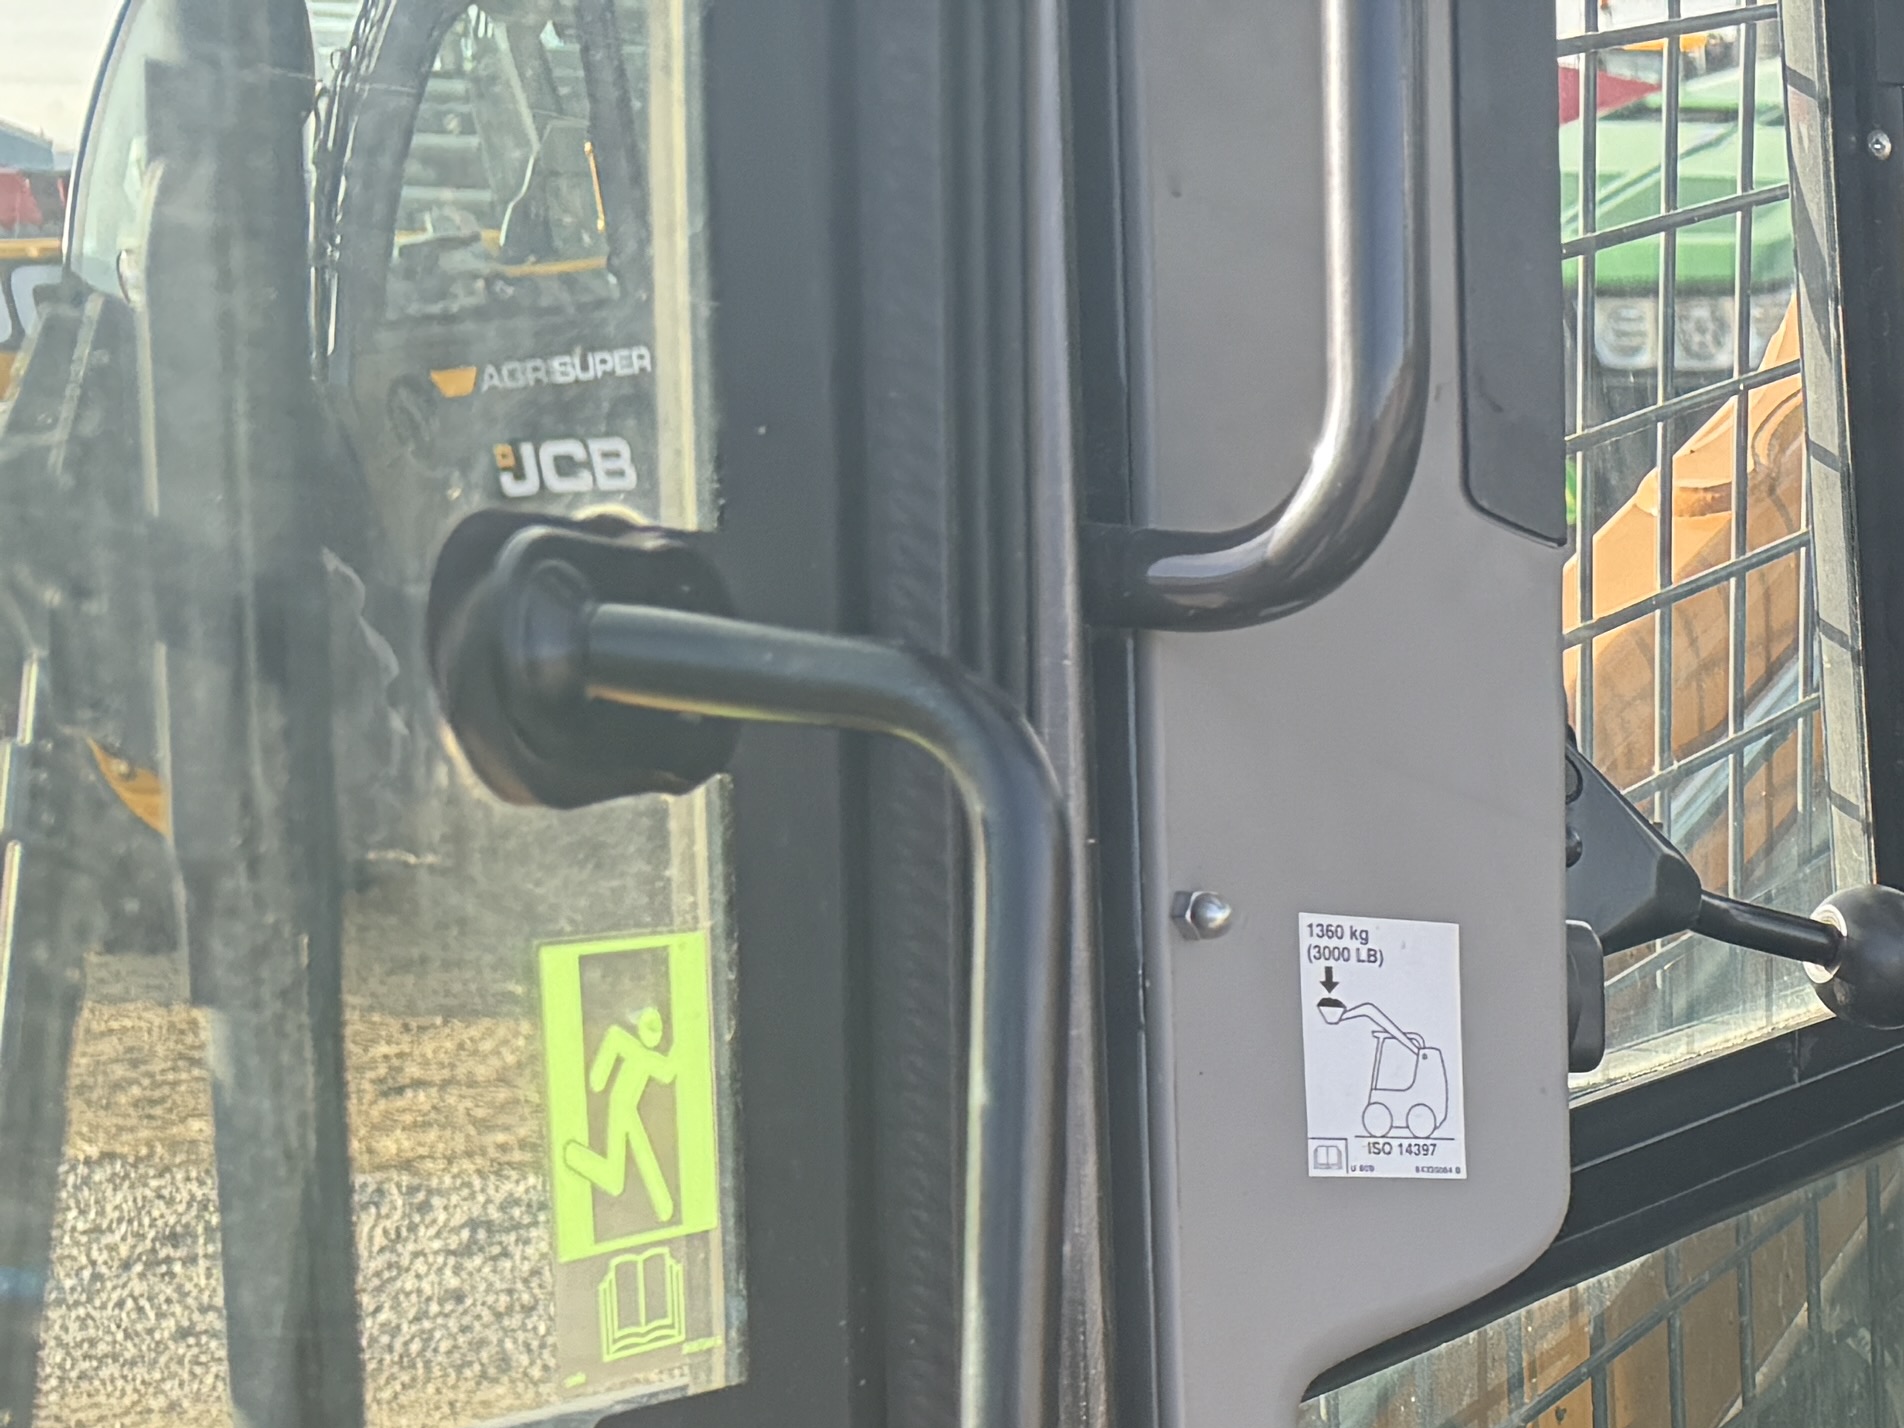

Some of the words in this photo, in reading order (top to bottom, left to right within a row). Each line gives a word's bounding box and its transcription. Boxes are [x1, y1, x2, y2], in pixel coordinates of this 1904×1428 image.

[493, 436, 638, 498] JCB
[1306, 922, 1344, 941] 1360
[1349, 925, 1369, 946] kg
[1307, 943, 1351, 964] (3000
[1356, 948, 1384, 968] LB)
[1368, 1141, 1393, 1156] ISO
[1397, 1142, 1437, 1157] 14397
